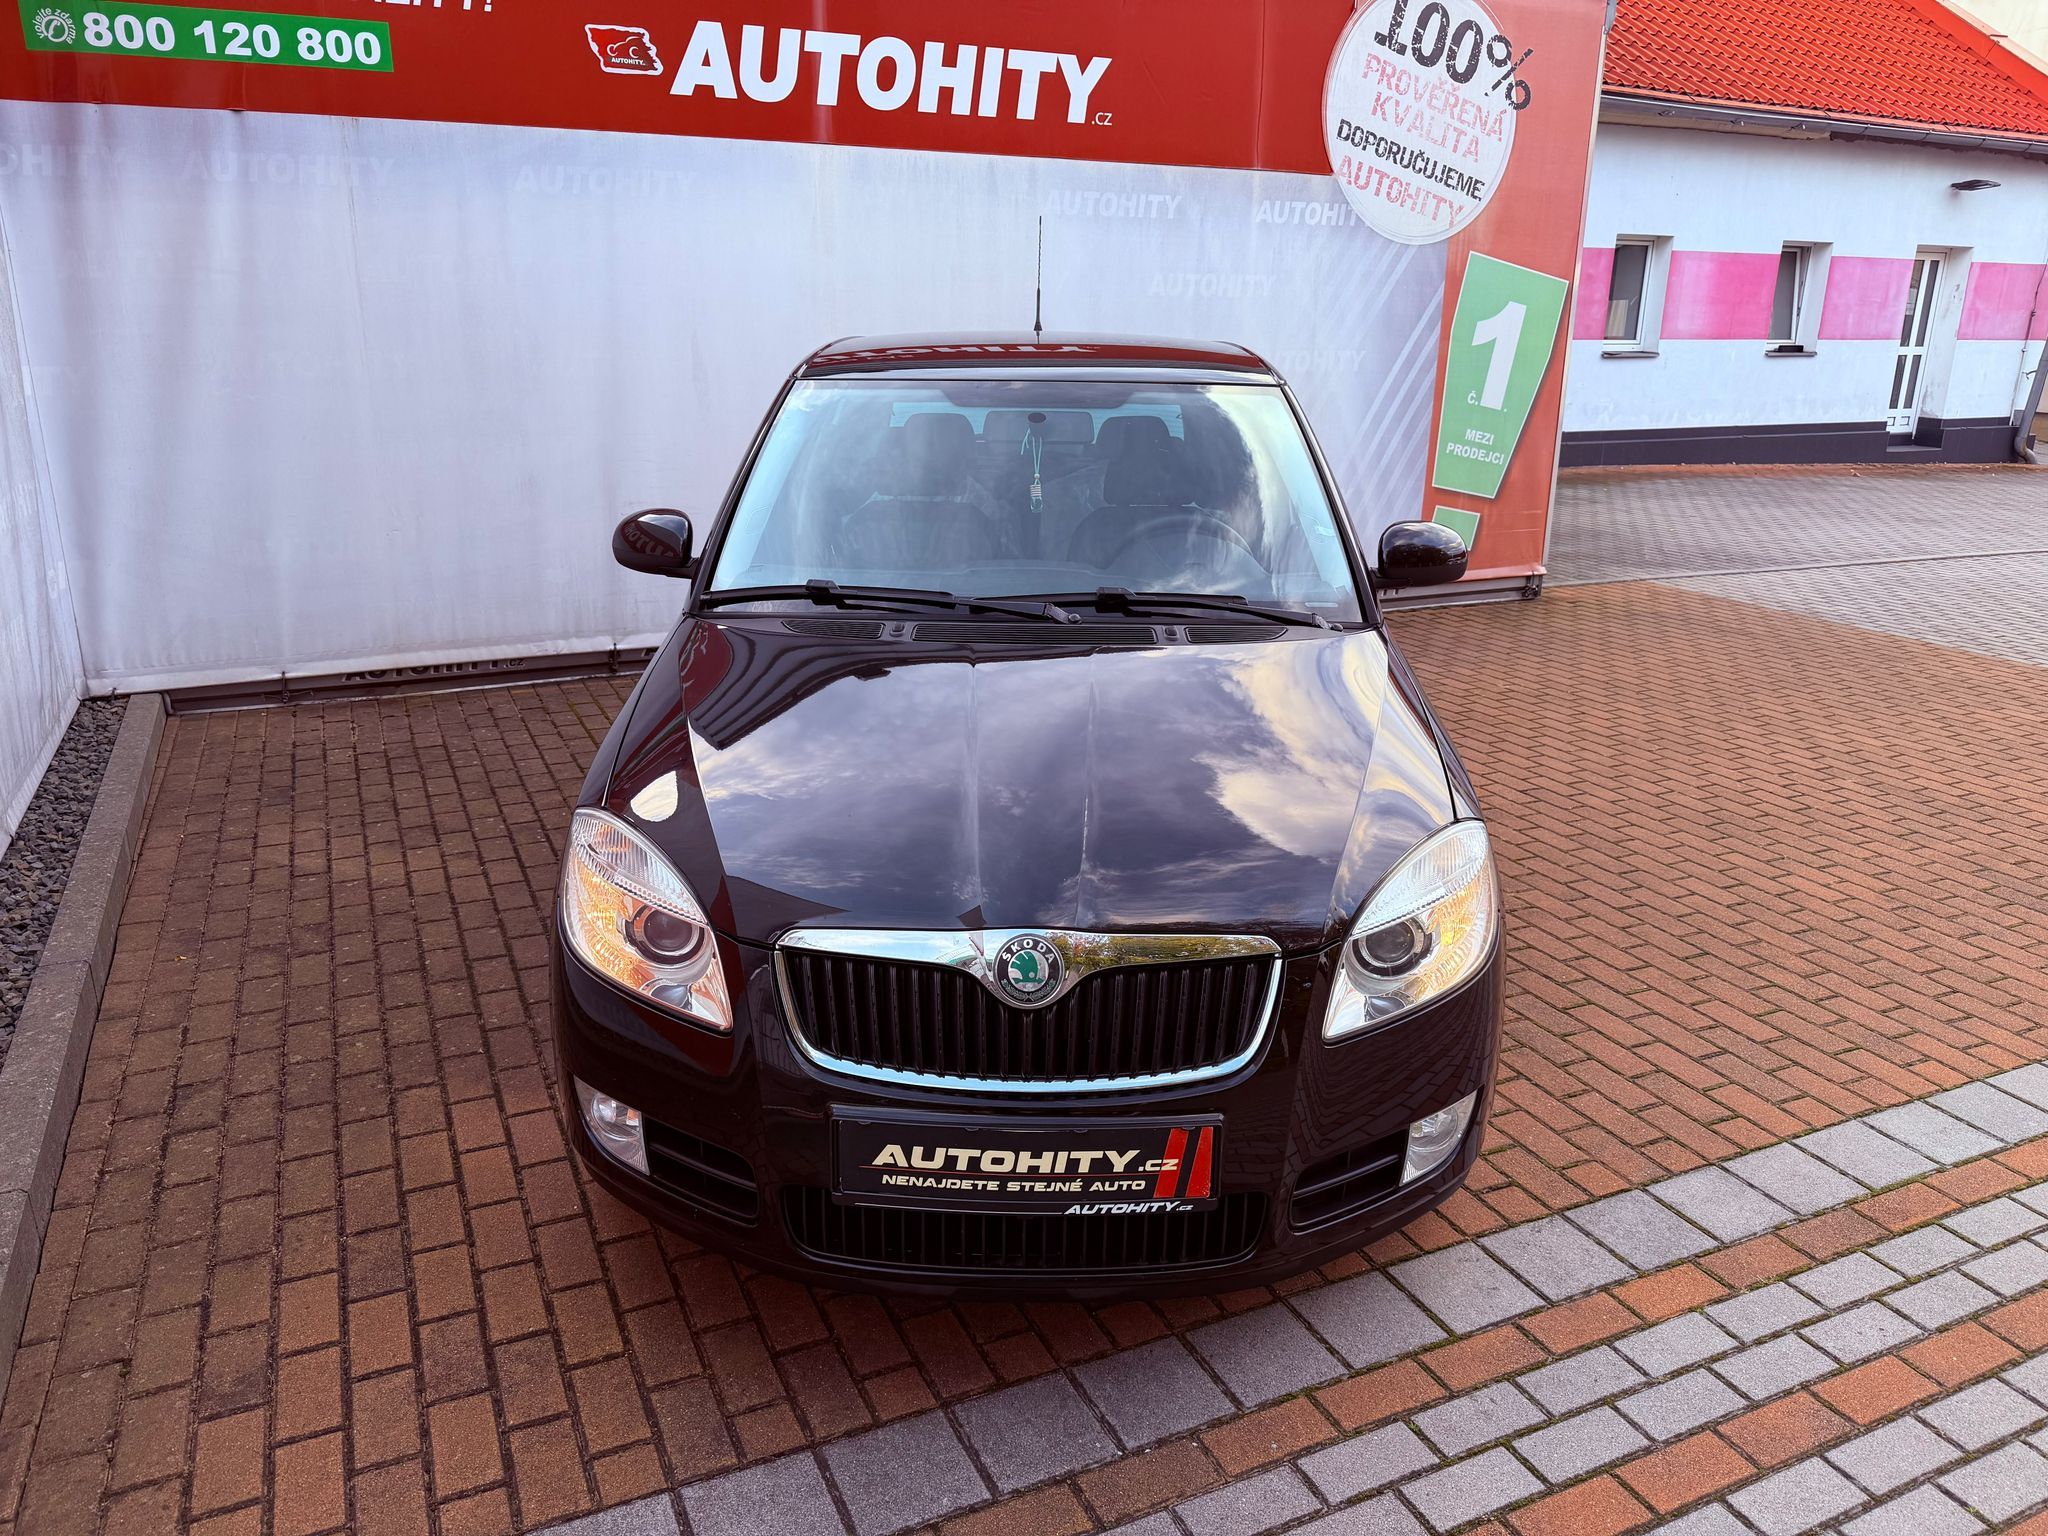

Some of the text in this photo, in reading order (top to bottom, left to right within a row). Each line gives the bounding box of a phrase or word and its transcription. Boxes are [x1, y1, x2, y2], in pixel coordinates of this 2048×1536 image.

[32, 8, 76, 45] volejte zdarma
[82, 12, 382, 65] 800 120 800
[1374, 0, 1534, 111] 100%
[1362, 52, 1509, 142] PROVĚŘENÁ
[1371, 91, 1480, 163] KVALITA
[1336, 118, 1486, 202] DOPORUČUJEME
[1042, 190, 1182, 220] AUTOHITY
[1336, 155, 1467, 229] AUTOHITY
[1254, 199, 1358, 227] AUTOHIT
[1147, 271, 1276, 299] AUTOHITY
[1446, 443, 1504, 465] PRODEJCI
[1465, 429, 1494, 445] MEZI
[881, 1174, 1146, 1193] NENAJDETE STEJNÉ AUTO
